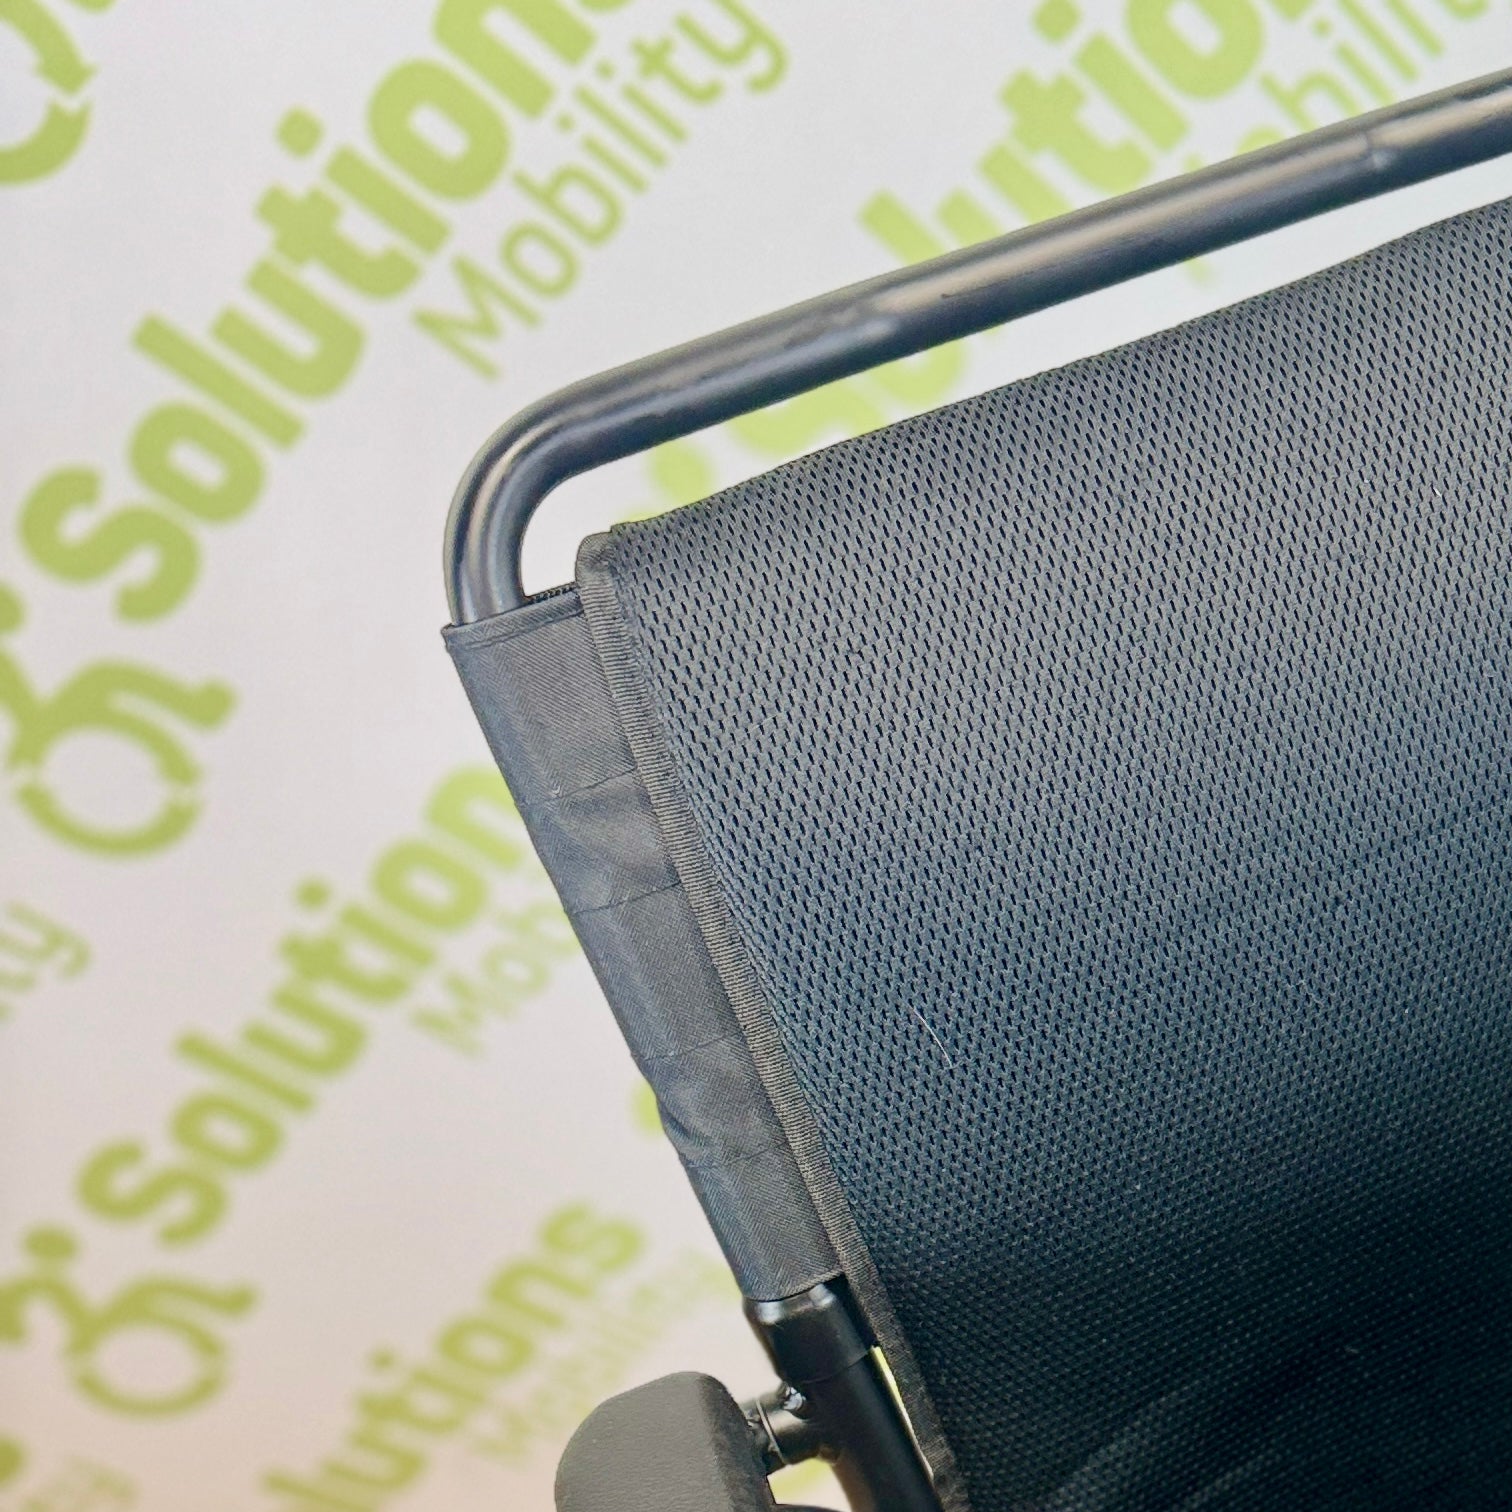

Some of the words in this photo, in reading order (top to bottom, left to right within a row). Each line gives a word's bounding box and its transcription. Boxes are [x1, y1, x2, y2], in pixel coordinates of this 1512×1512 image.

[16, 0, 635, 624] Solution
[411, 0, 791, 380] Mobility
[76, 765, 528, 1247] Solution
